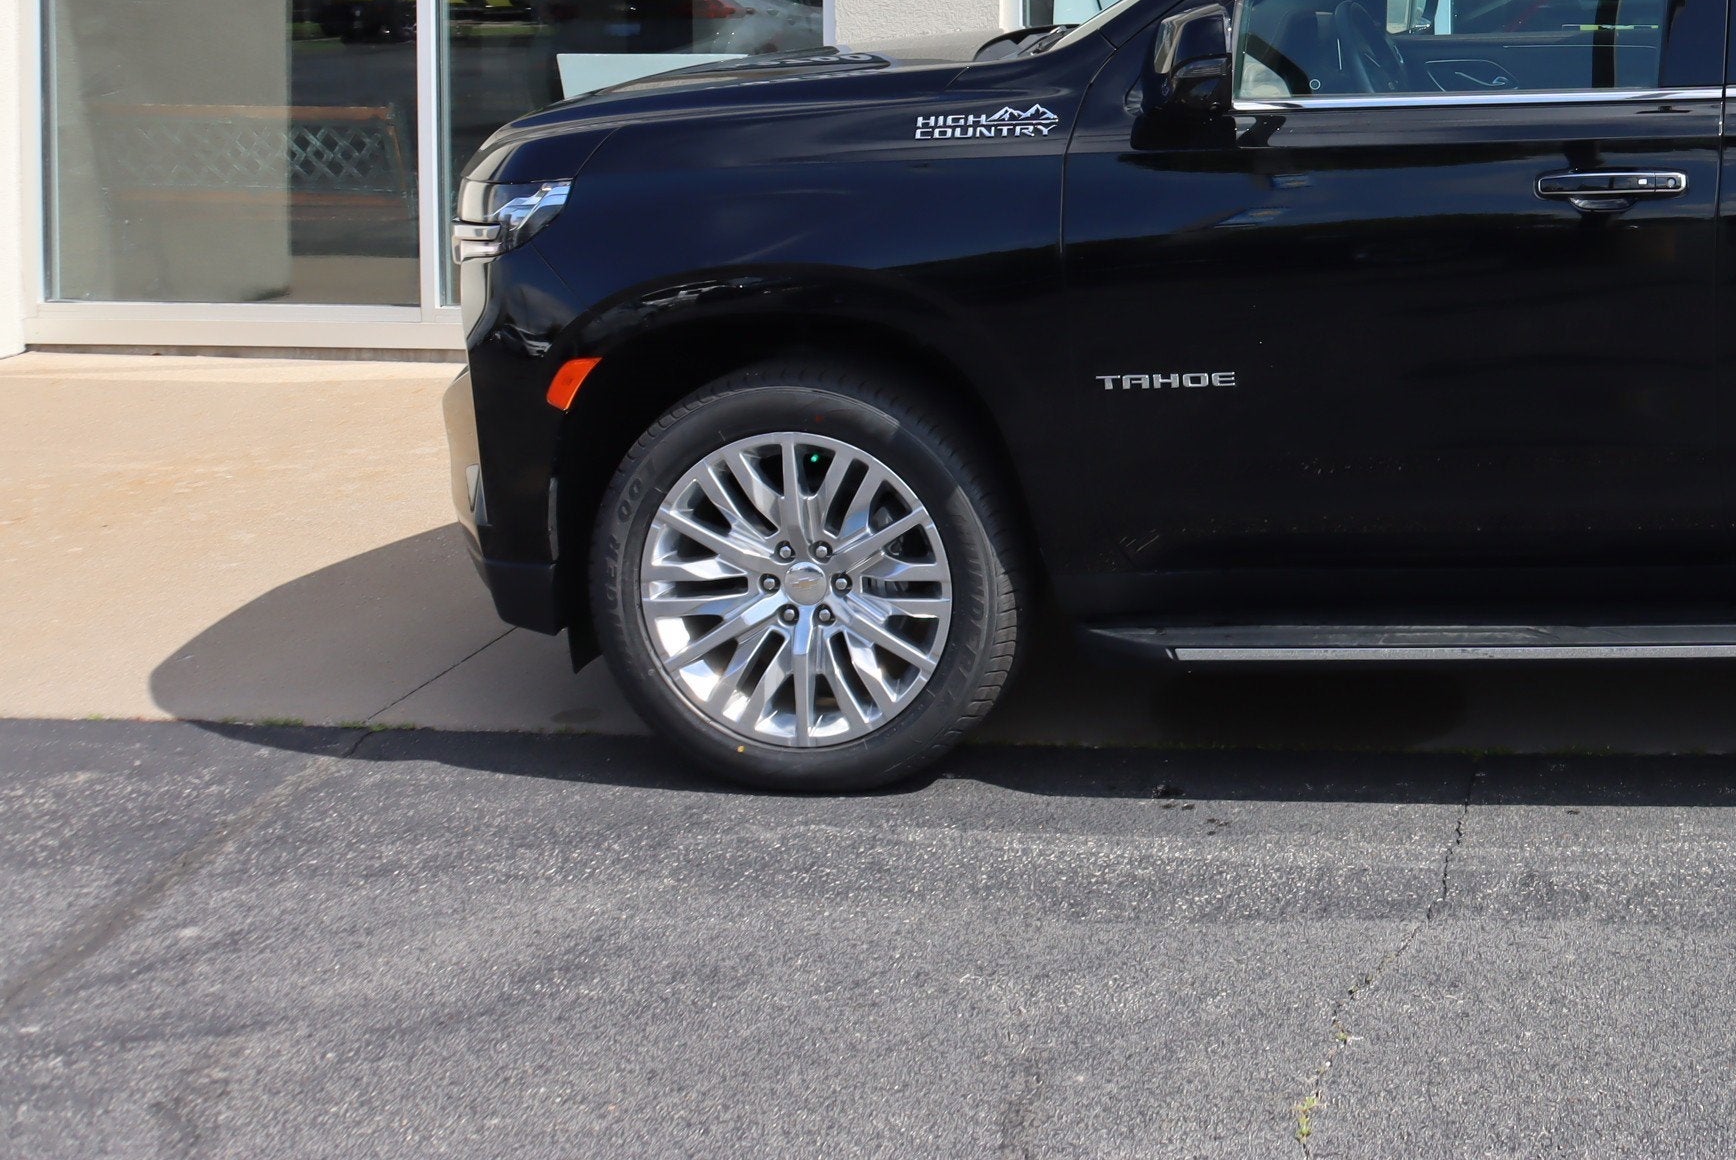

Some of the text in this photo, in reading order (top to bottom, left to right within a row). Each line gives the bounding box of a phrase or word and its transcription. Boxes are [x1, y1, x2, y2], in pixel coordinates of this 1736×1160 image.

[915, 114, 988, 128] HIGH
[914, 124, 1057, 140] COUNTRY
[1095, 371, 1237, 391] TAHOE
